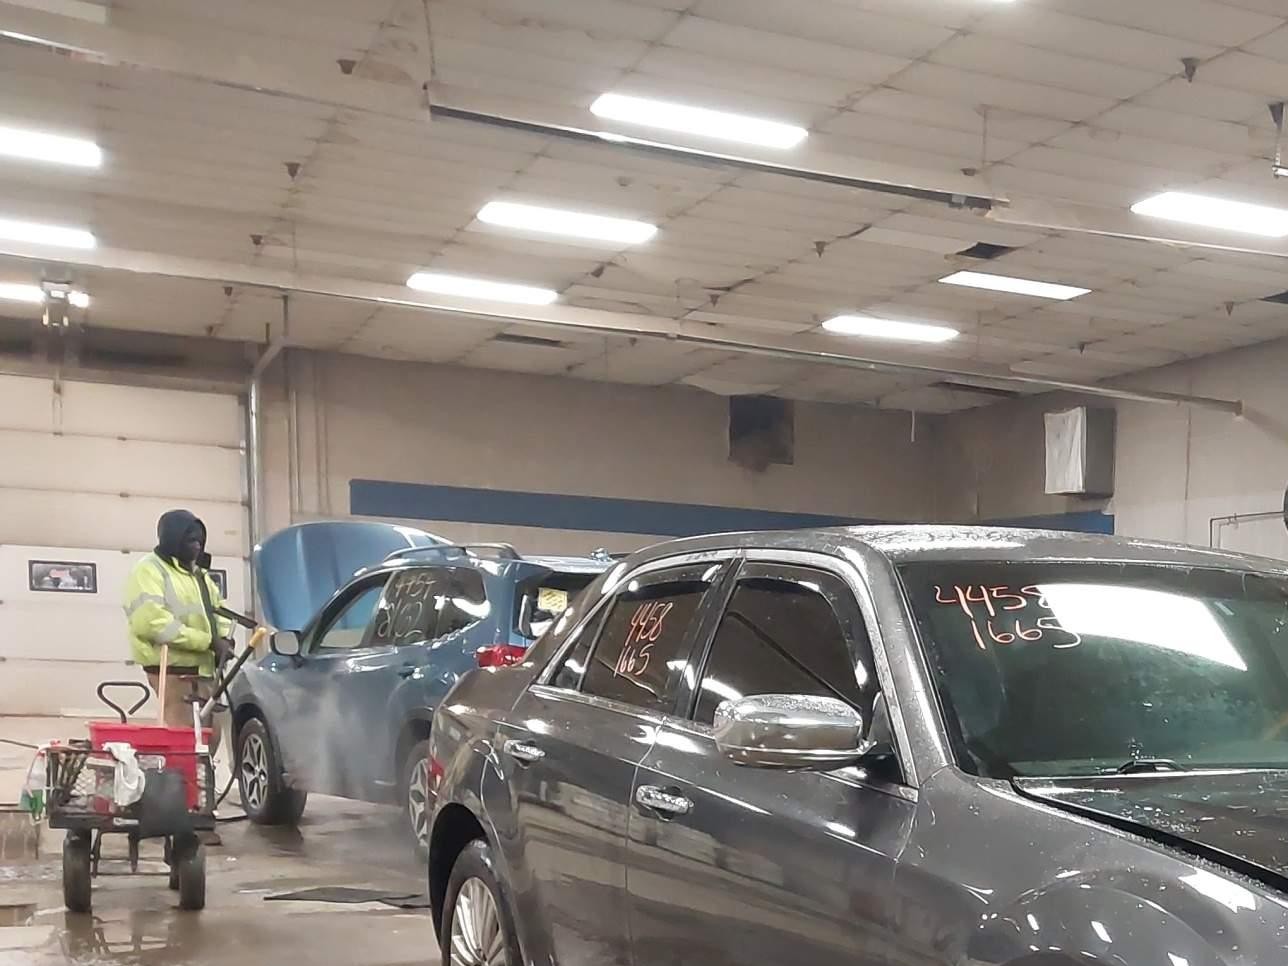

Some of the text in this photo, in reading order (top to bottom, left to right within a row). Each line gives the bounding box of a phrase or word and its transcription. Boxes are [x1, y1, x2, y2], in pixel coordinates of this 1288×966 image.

[625, 601, 673, 646] 4458
[970, 617, 1082, 649] 1665
[613, 643, 655, 678] 1665
